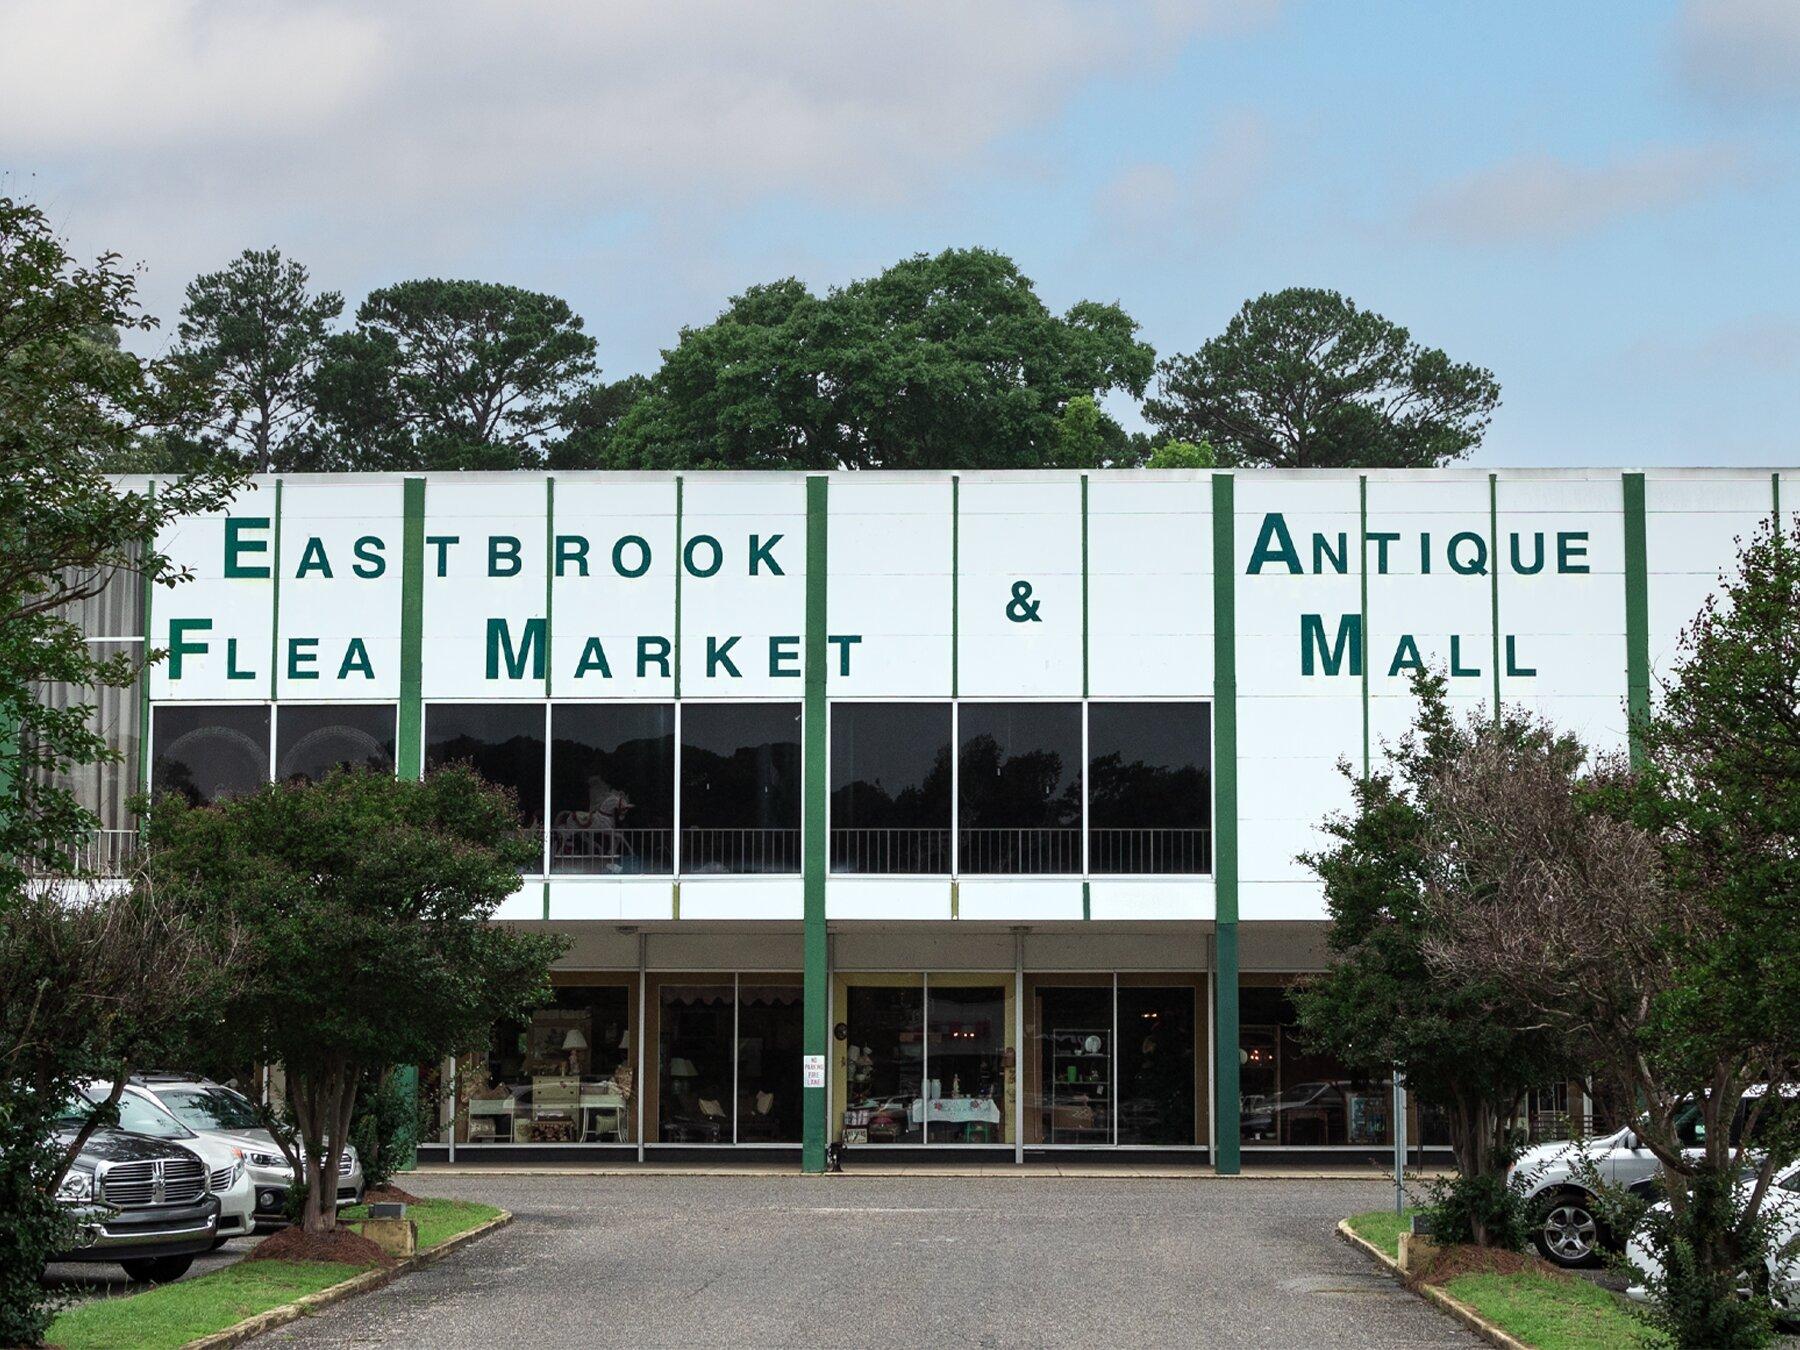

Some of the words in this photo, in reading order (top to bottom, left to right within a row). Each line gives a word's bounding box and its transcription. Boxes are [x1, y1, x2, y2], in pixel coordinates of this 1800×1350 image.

[224, 517, 786, 579] EASTBROOK
[1246, 512, 1590, 576] ANTIQUE
[1005, 580, 1043, 623] &
[168, 618, 376, 680] FLEA
[486, 617, 862, 680] MARKET
[1301, 613, 1537, 677] MALL
